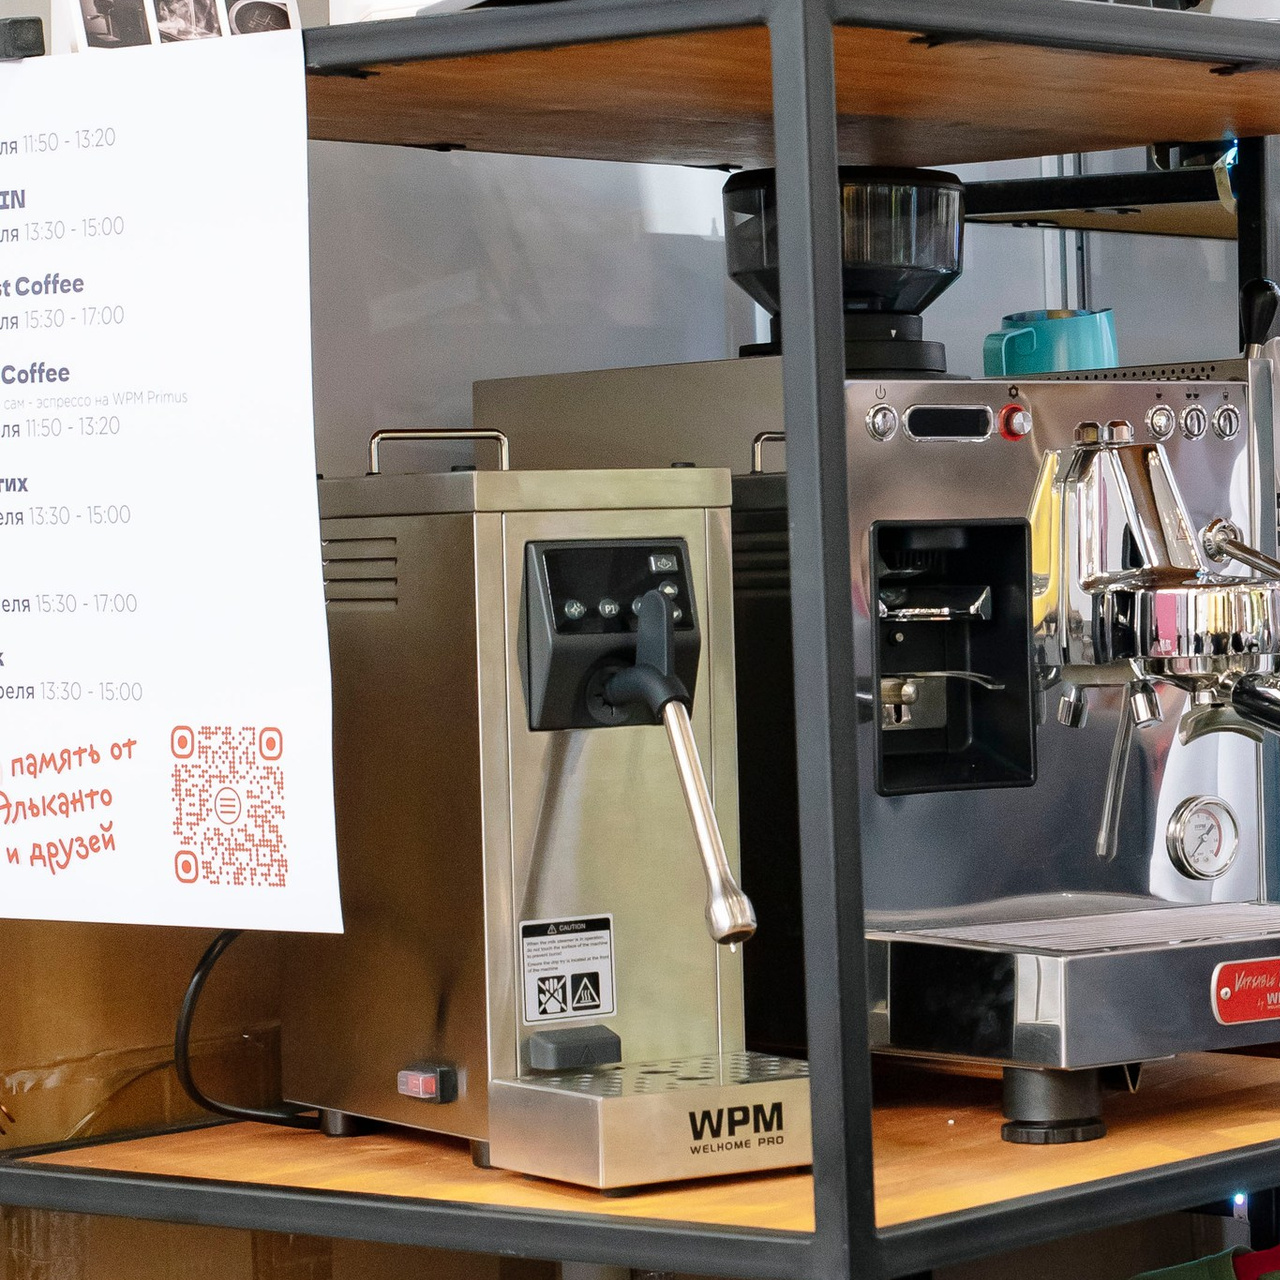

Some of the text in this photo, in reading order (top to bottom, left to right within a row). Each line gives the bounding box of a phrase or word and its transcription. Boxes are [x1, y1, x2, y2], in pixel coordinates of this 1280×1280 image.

[24, 127, 116, 153] 11:50 13:20
[25, 216, 124, 241] 13:30 15:00
[15, 273, 84, 296] Coffee
[25, 305, 124, 329] 15:30 17:00
[1, 362, 70, 385] Coffee
[37, 390, 188, 410] эспрессо WPM Primus
[1, 416, 120, 438] ля 11:50 13:20
[29, 505, 130, 526] 13:30 15:00
[36, 594, 76, 612] 15:30
[94, 594, 137, 612] 17:00
[605, 605, 616, 614] P1
[41, 682, 142, 701] 13:30 15:00
[12, 738, 137, 778] память от
[6, 821, 115, 875] и друзей
[559, 923, 586, 931] CAUTION
[689, 1102, 783, 1140] WPM
[690, 1136, 784, 1154] WELHOME PRO
